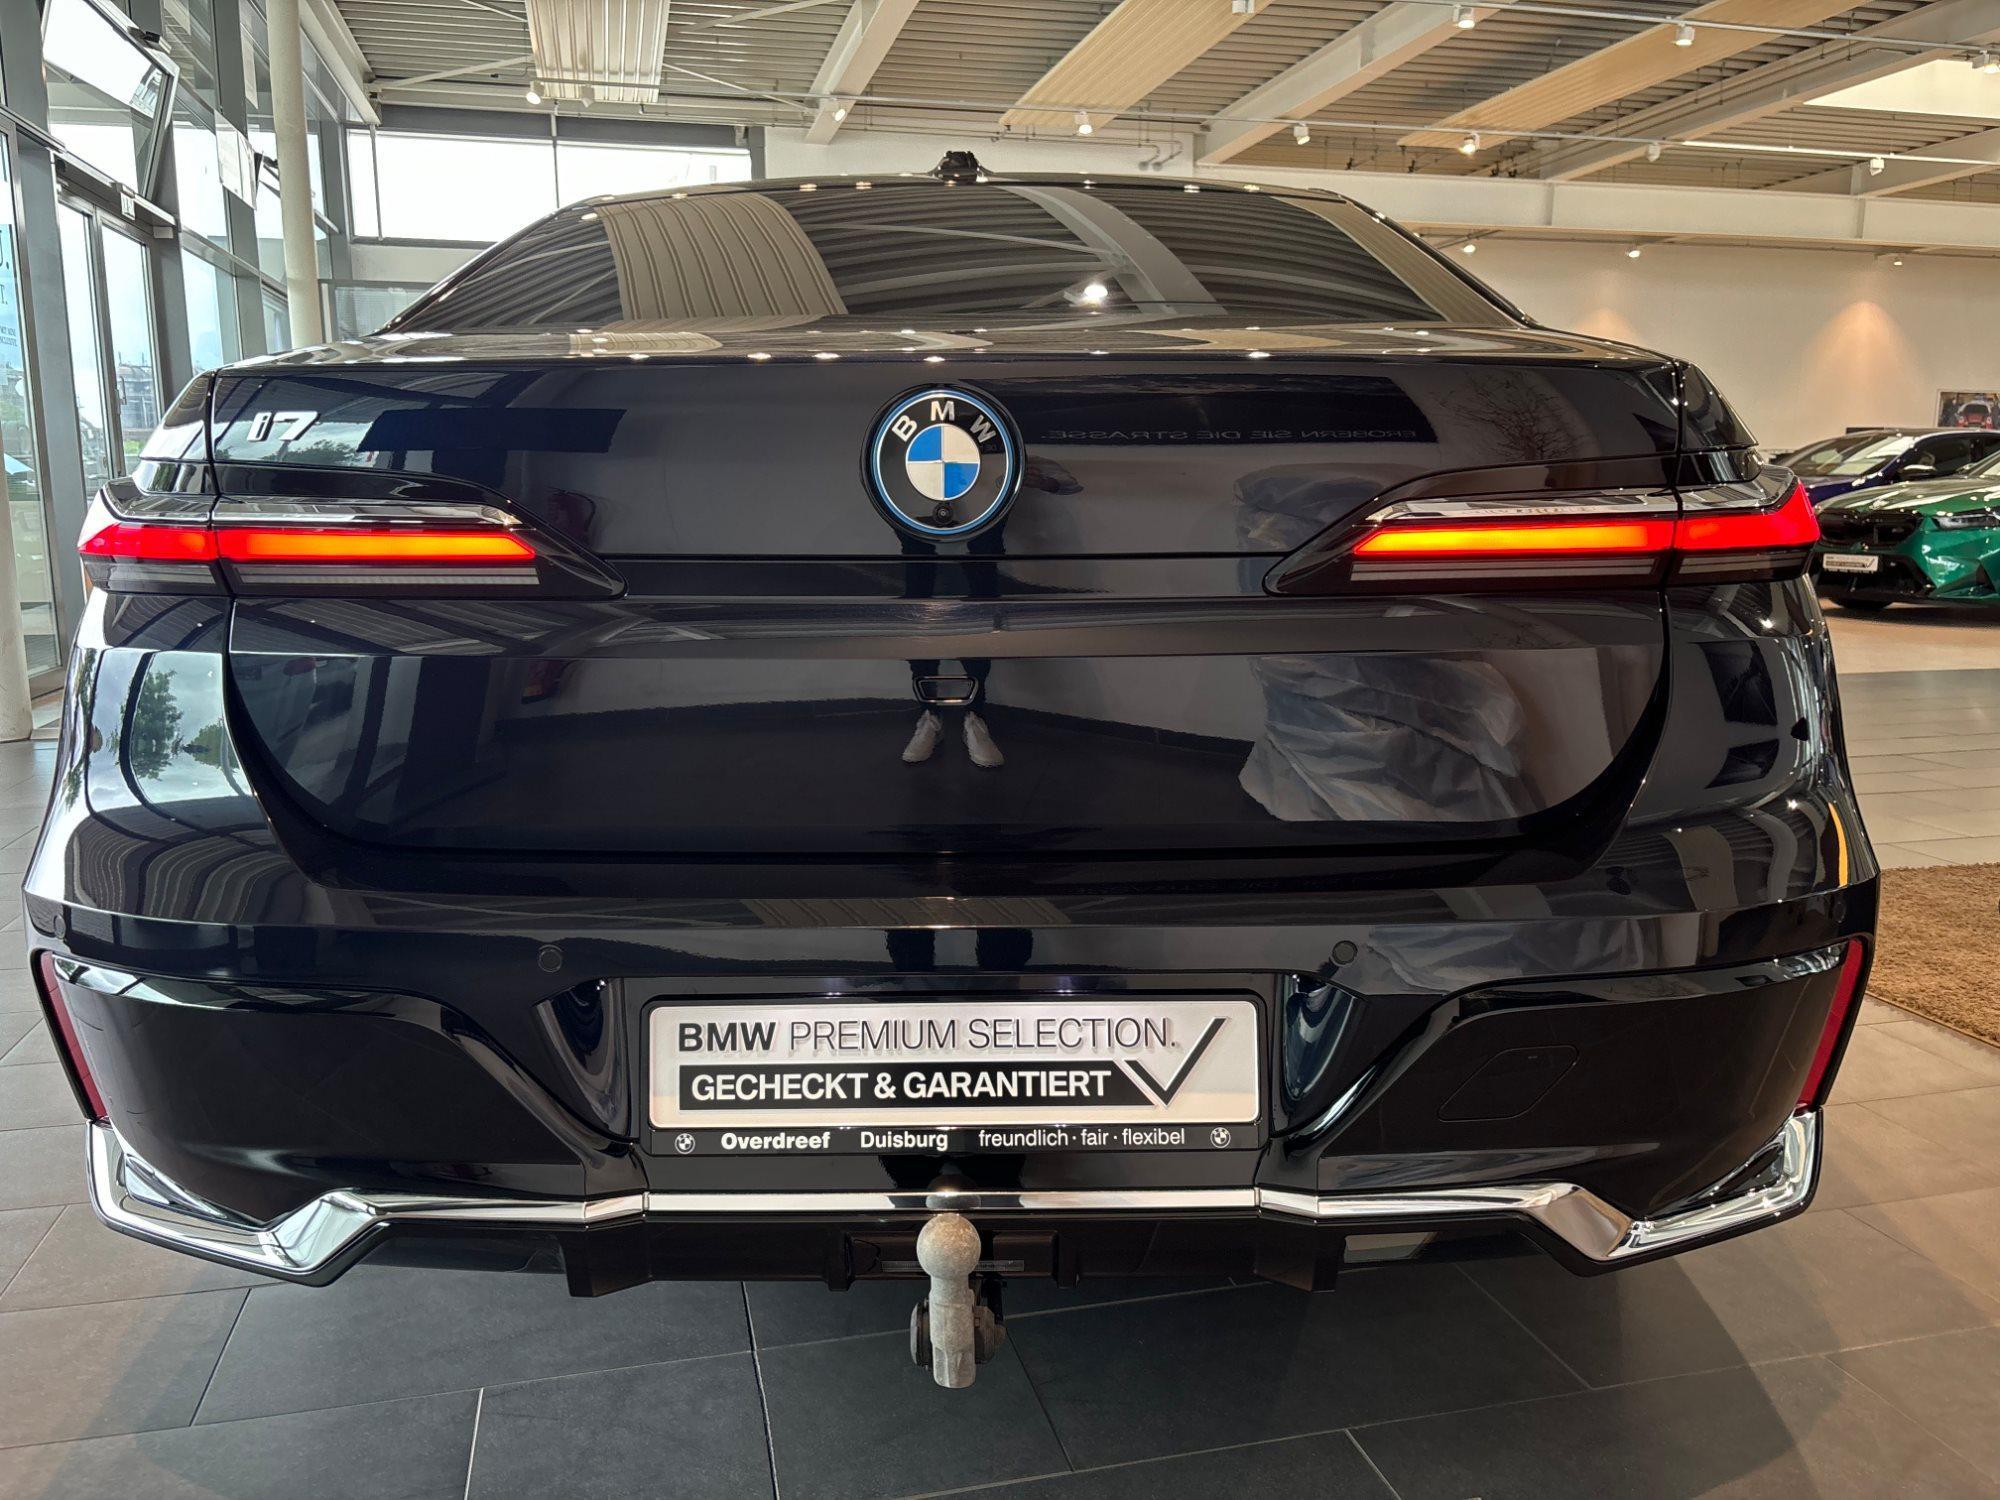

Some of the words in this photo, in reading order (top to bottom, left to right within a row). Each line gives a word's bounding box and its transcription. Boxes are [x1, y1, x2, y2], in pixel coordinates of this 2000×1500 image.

[247, 411, 319, 442] i7
[891, 400, 997, 443] BMW
[678, 1021, 777, 1052] BMW
[790, 1019, 956, 1050] PREMIUM
[968, 1017, 1177, 1049] SELECTION.
[691, 1072, 869, 1101] GECHECKT
[875, 1071, 897, 1099] &
[902, 1070, 1112, 1098] GARANTIERT
[720, 1131, 831, 1150] Overdreef
[860, 1131, 949, 1152] Duisburg
[978, 1129, 1069, 1147] freundlich
[1080, 1128, 1110, 1146] fair
[1121, 1127, 1186, 1145] flexibel
